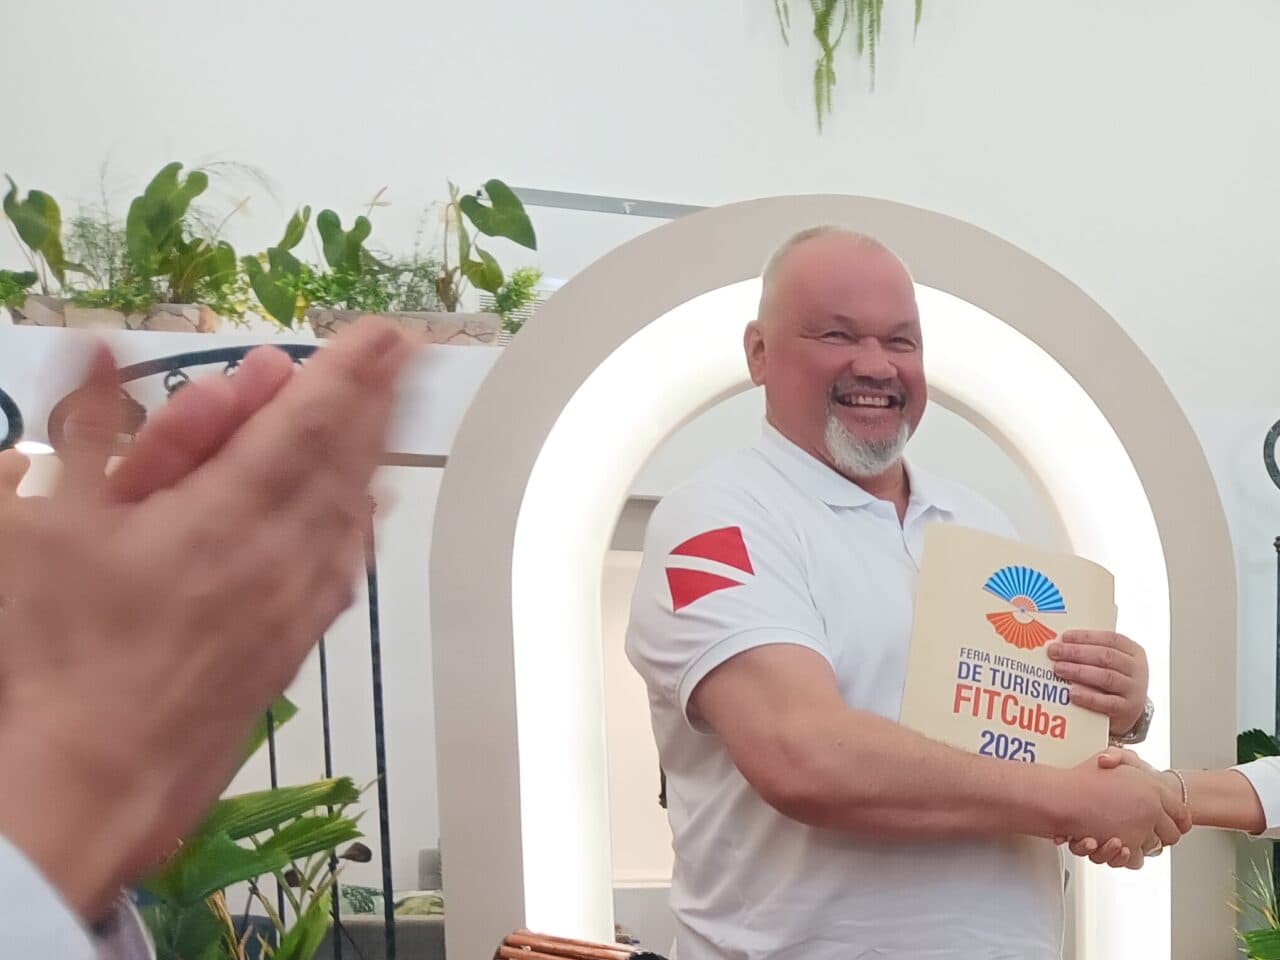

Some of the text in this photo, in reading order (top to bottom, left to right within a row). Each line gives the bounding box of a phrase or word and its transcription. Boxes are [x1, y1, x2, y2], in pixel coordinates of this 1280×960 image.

[960, 647, 991, 664] FERIA
[957, 661, 1071, 706] DE TURISMO
[953, 683, 1067, 739] FITCuba
[979, 730, 1036, 763] 2025
